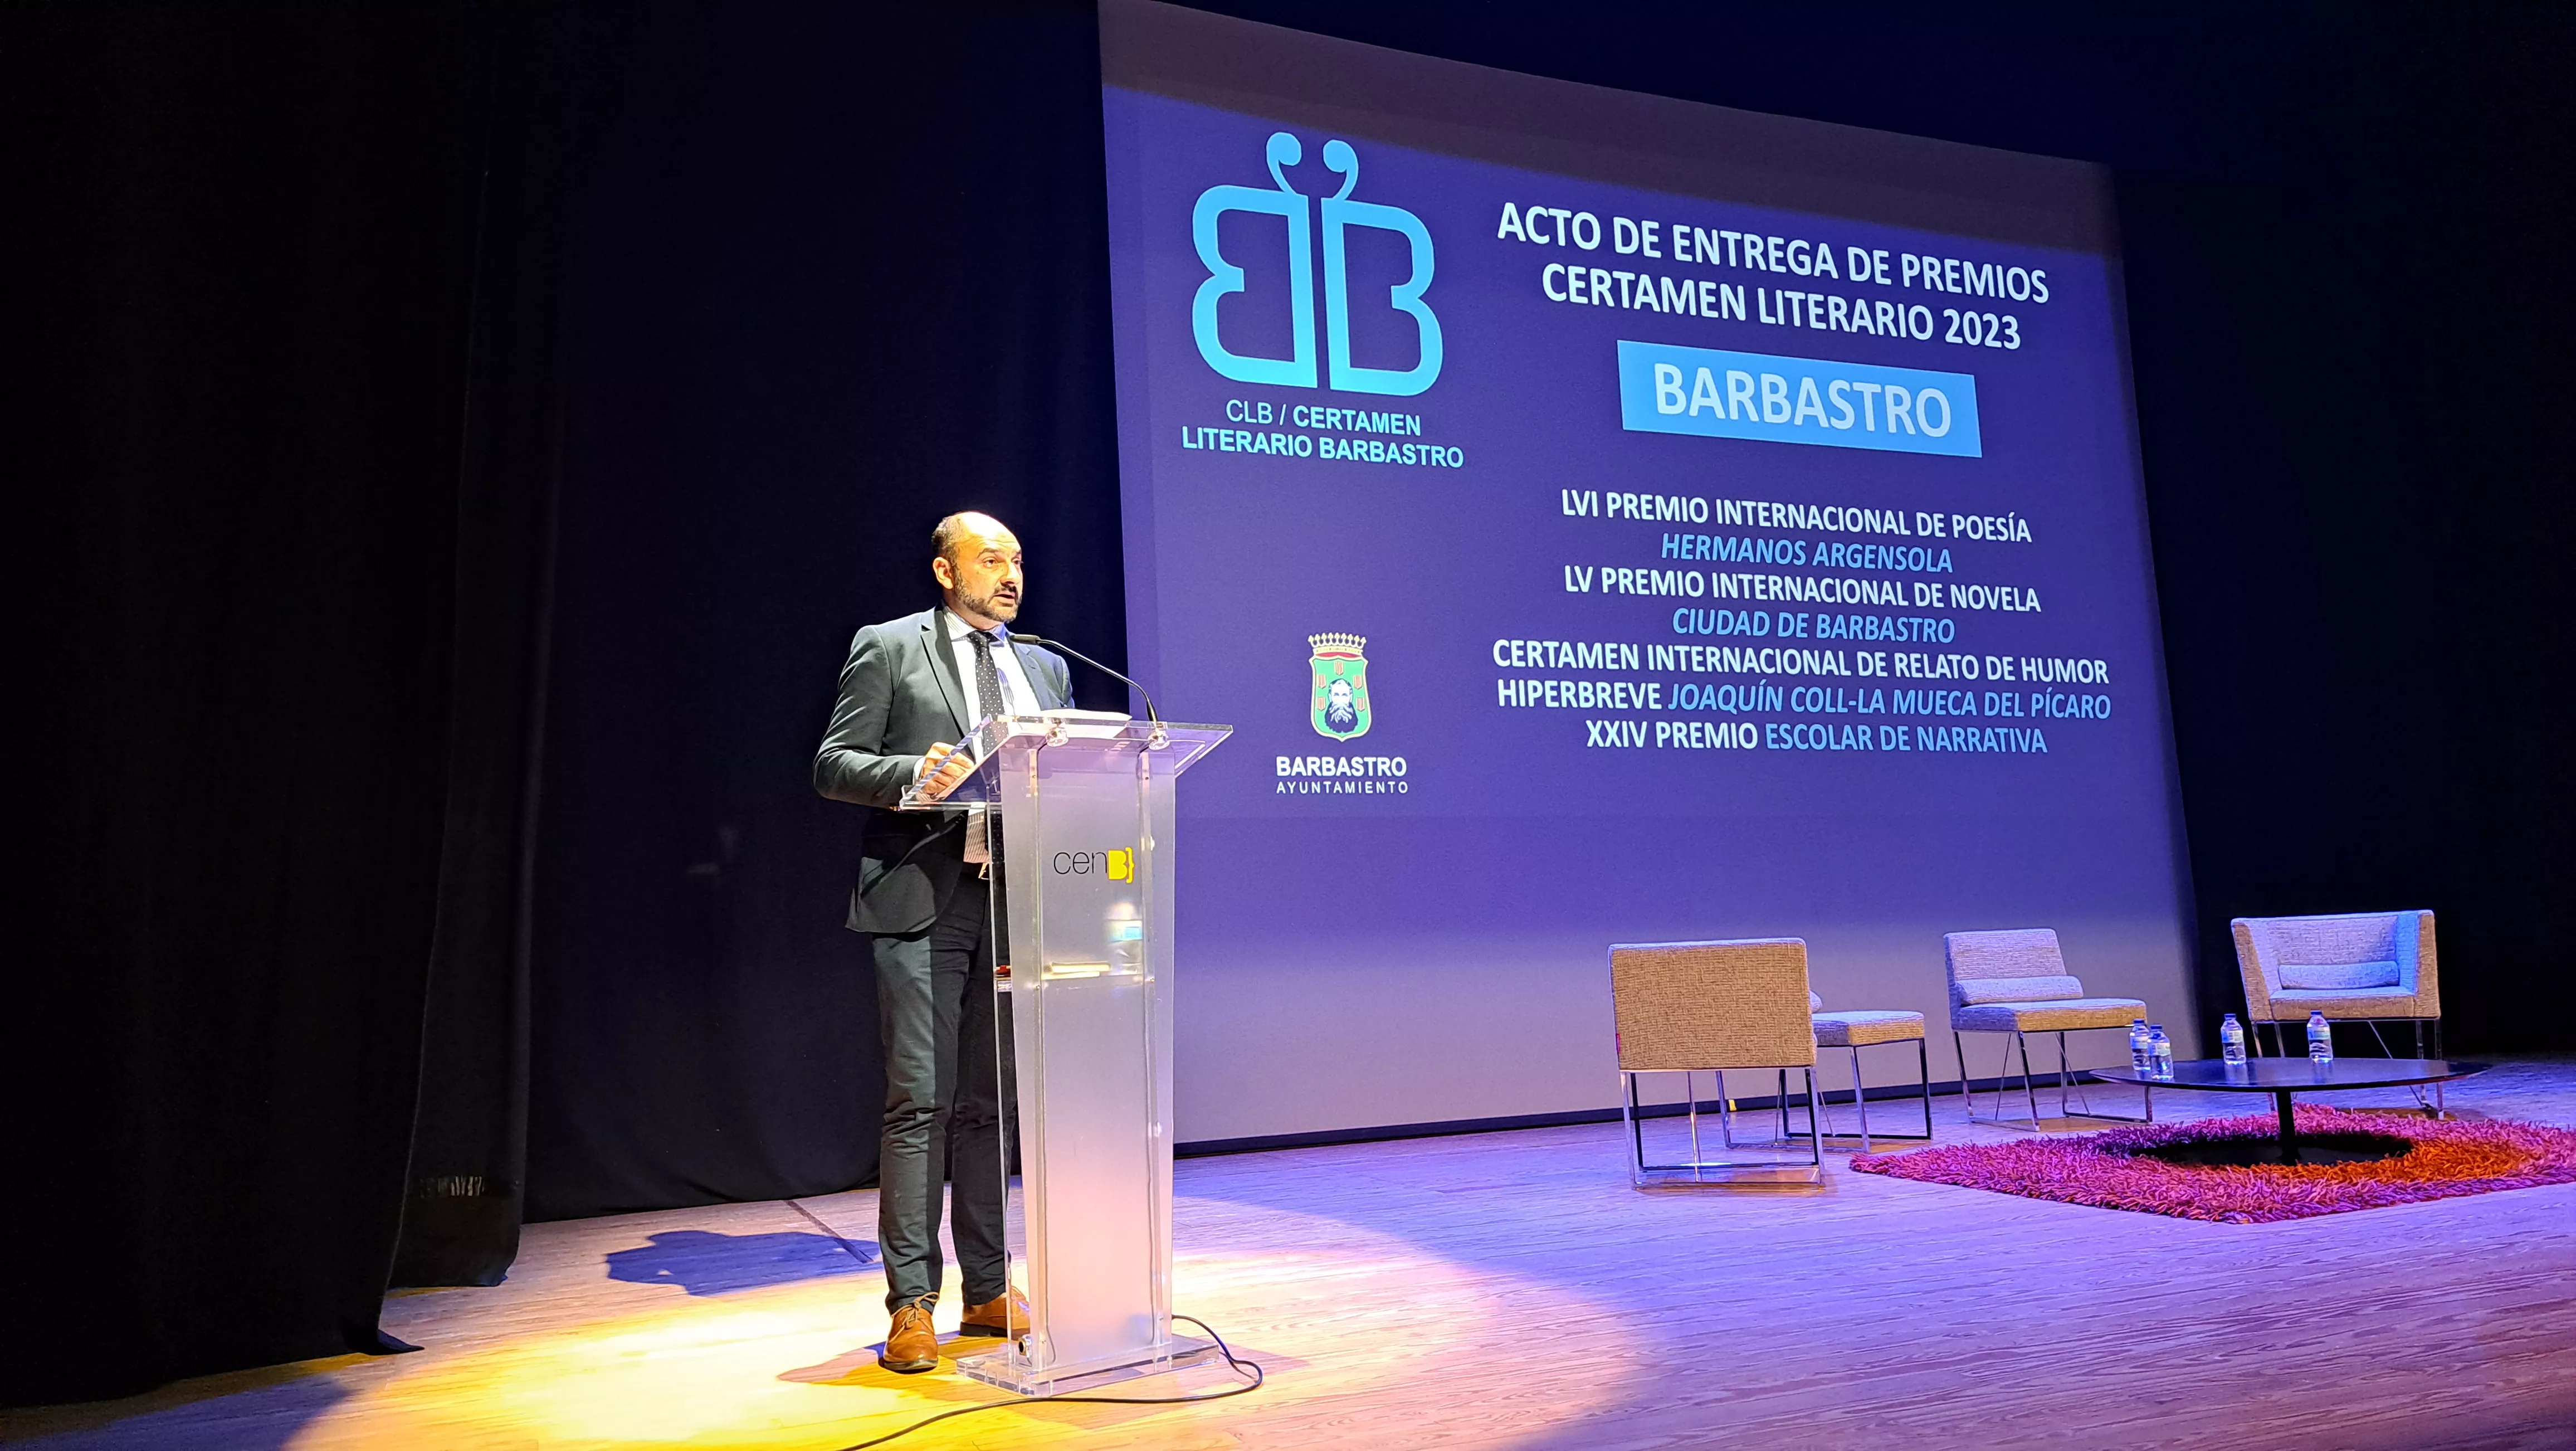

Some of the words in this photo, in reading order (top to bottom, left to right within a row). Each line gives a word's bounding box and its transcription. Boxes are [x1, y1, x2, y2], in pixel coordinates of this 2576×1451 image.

[1497, 202, 1601, 250] ACTO
[1613, 217, 1661, 259] DE
[1672, 225, 1839, 279] ENTREGA
[1847, 246, 1892, 285] DE
[1901, 253, 2049, 303] PREMIOS
[1543, 263, 1746, 321] CERTAMEN
[1757, 288, 1934, 340] LITERARIO
[1943, 309, 2021, 349] 2023
[1226, 400, 1273, 424] CLB
[1293, 405, 1421, 436] CERTAMEN
[1655, 363, 1951, 437] BARBASTRO
[1182, 426, 1312, 457] LITERARIO
[1319, 437, 1463, 468] BARBASTRO
[1562, 489, 1598, 517] LVI
[1606, 492, 1708, 523] PREMIO
[1716, 499, 1911, 535] INTERNACIONAL
[1916, 512, 1946, 537] DE
[1951, 512, 2032, 543] POESÍA
[1661, 533, 1806, 566] HERMANOS
[1812, 542, 1953, 573] ARGENSOLA
[1565, 565, 1593, 592] LV
[1601, 567, 1704, 597] PREMIO
[1712, 572, 1909, 606] INTERNACIONAL
[1914, 582, 1944, 607] DE
[1950, 584, 2042, 612] NOVELA
[1673, 607, 1770, 636] CIUDAD
[1777, 612, 1809, 638] DE
[1816, 613, 1955, 644] BARBASTRO
[1493, 639, 1639, 670] CERTAMEN
[1647, 644, 1852, 676] INTERNACIONAL
[1857, 651, 1888, 677] DE
[1894, 653, 1979, 680] RELATO
[1985, 656, 2016, 681] DE
[2021, 657, 2109, 684] HUMOR
[1497, 679, 1662, 709] HIPERBREVE
[1667, 679, 1783, 715] JOAQUÍN
[1790, 686, 1886, 714] COLL-LA
[1892, 689, 1977, 716] MUECA
[1984, 692, 2024, 717] DEL
[2031, 686, 2111, 719] PÍCARO
[1585, 720, 1647, 748] XXIV
[1656, 721, 1758, 749] PREMIO
[1765, 723, 1874, 751] ESCOLAR
[1879, 725, 1911, 751] DE
[1917, 726, 2048, 753] NARRATIVA
[1276, 756, 1407, 777] BARBASTRO
[1276, 781, 1408, 794] AYUNTAMIENTO
